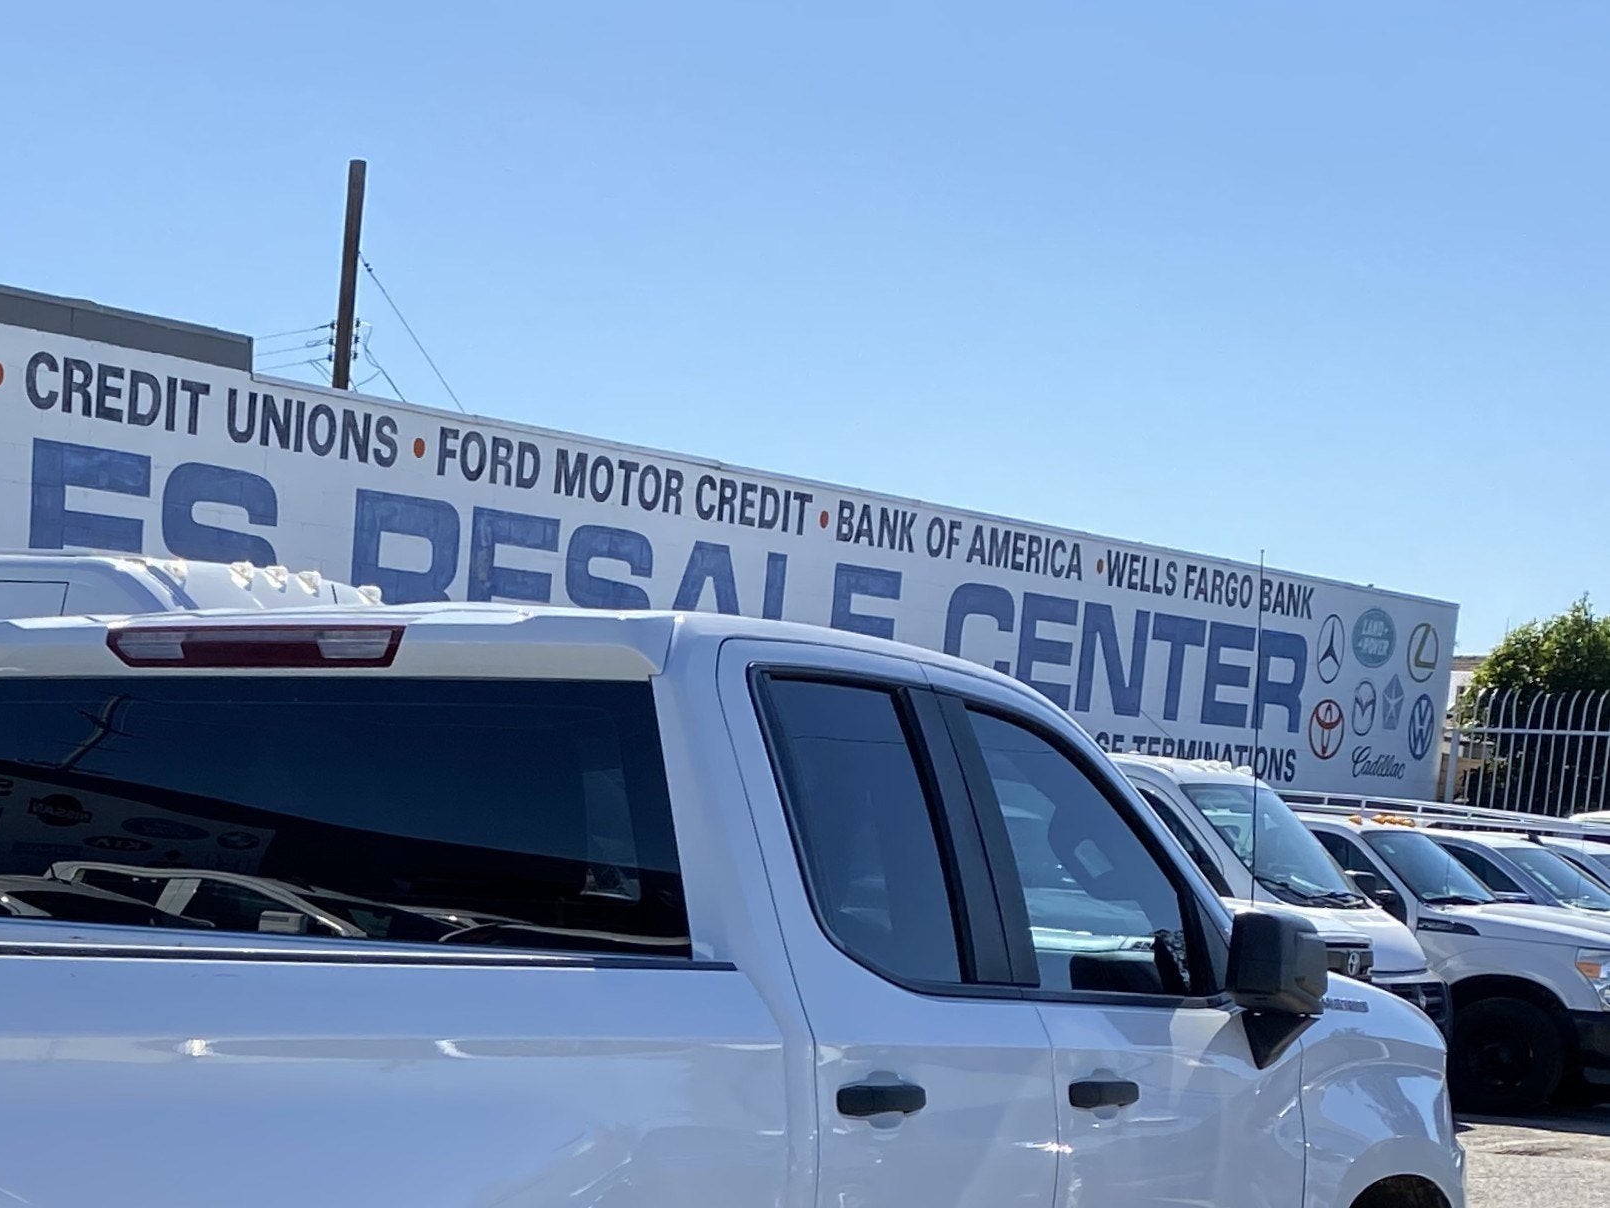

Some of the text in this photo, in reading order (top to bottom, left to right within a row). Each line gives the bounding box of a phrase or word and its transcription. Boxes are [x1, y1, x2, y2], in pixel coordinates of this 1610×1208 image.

[25, 351, 398, 467] CREDIT UNIONS
[437, 426, 813, 536] FORD MOTOR CREDIT
[836, 499, 1082, 581] BANK OF AMERICA
[1107, 549, 1315, 620] WELLS FARGO BANK
[944, 582, 1308, 733] CENTER
[1351, 745, 1406, 780] Cadillac
